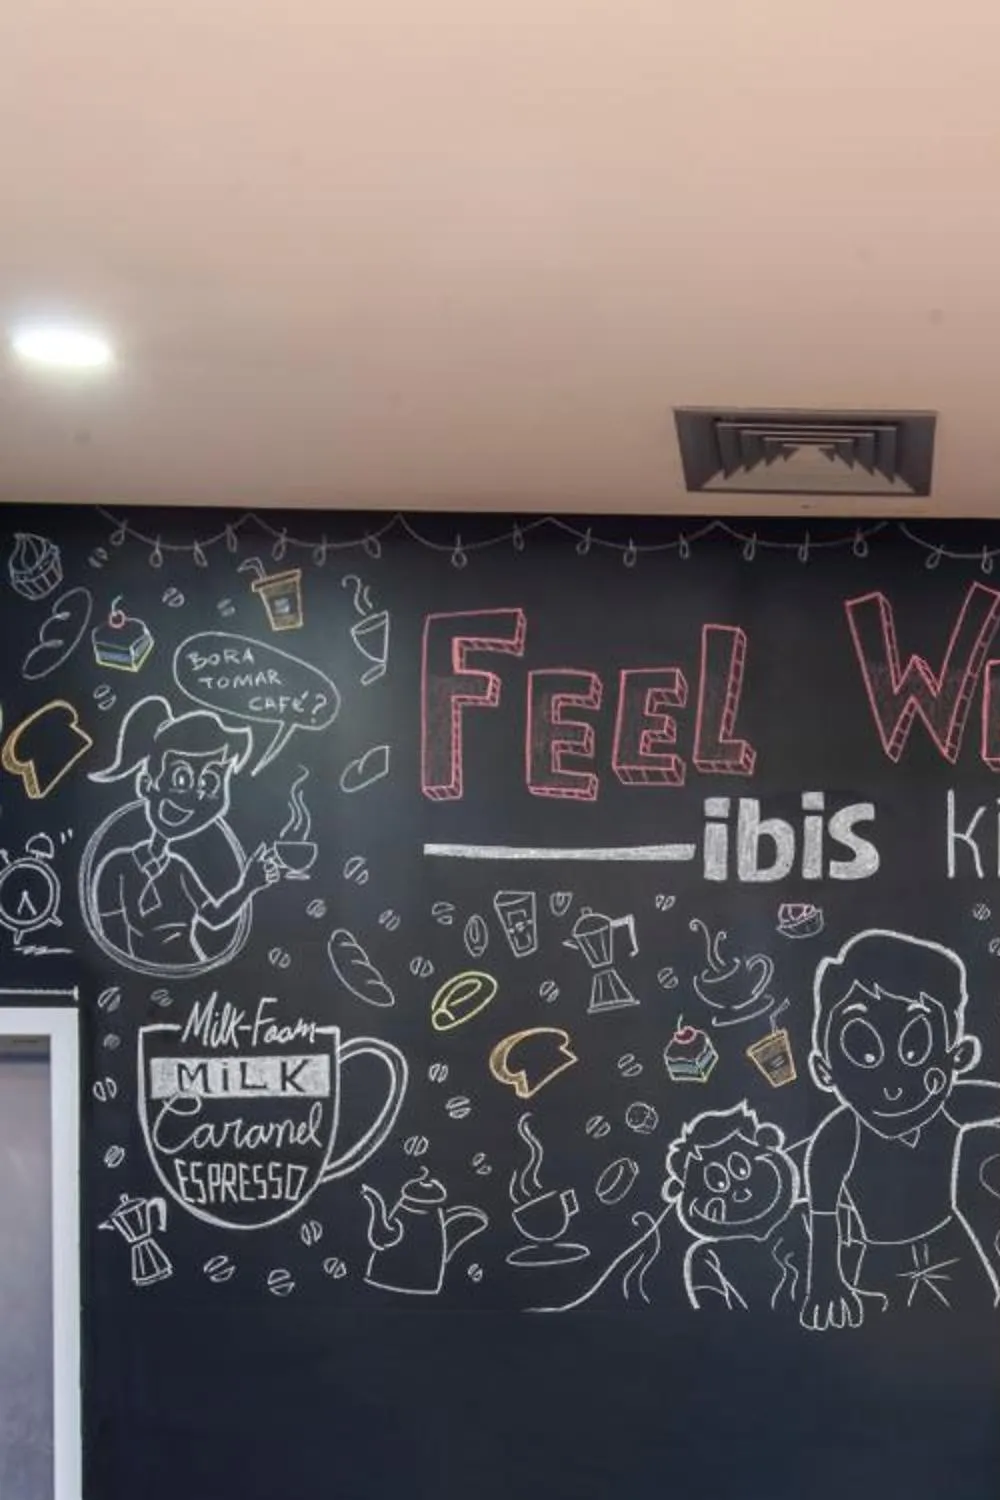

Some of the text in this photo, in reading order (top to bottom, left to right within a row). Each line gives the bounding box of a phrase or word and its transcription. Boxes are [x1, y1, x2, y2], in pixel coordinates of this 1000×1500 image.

[186, 648, 255, 671] BORA
[198, 669, 282, 689] TOMAR
[421, 608, 757, 800] FEEL
[703, 791, 881, 881] ibis
[153, 1094, 323, 1154] Caramel
[174, 1158, 308, 1204] ESPRESSO
